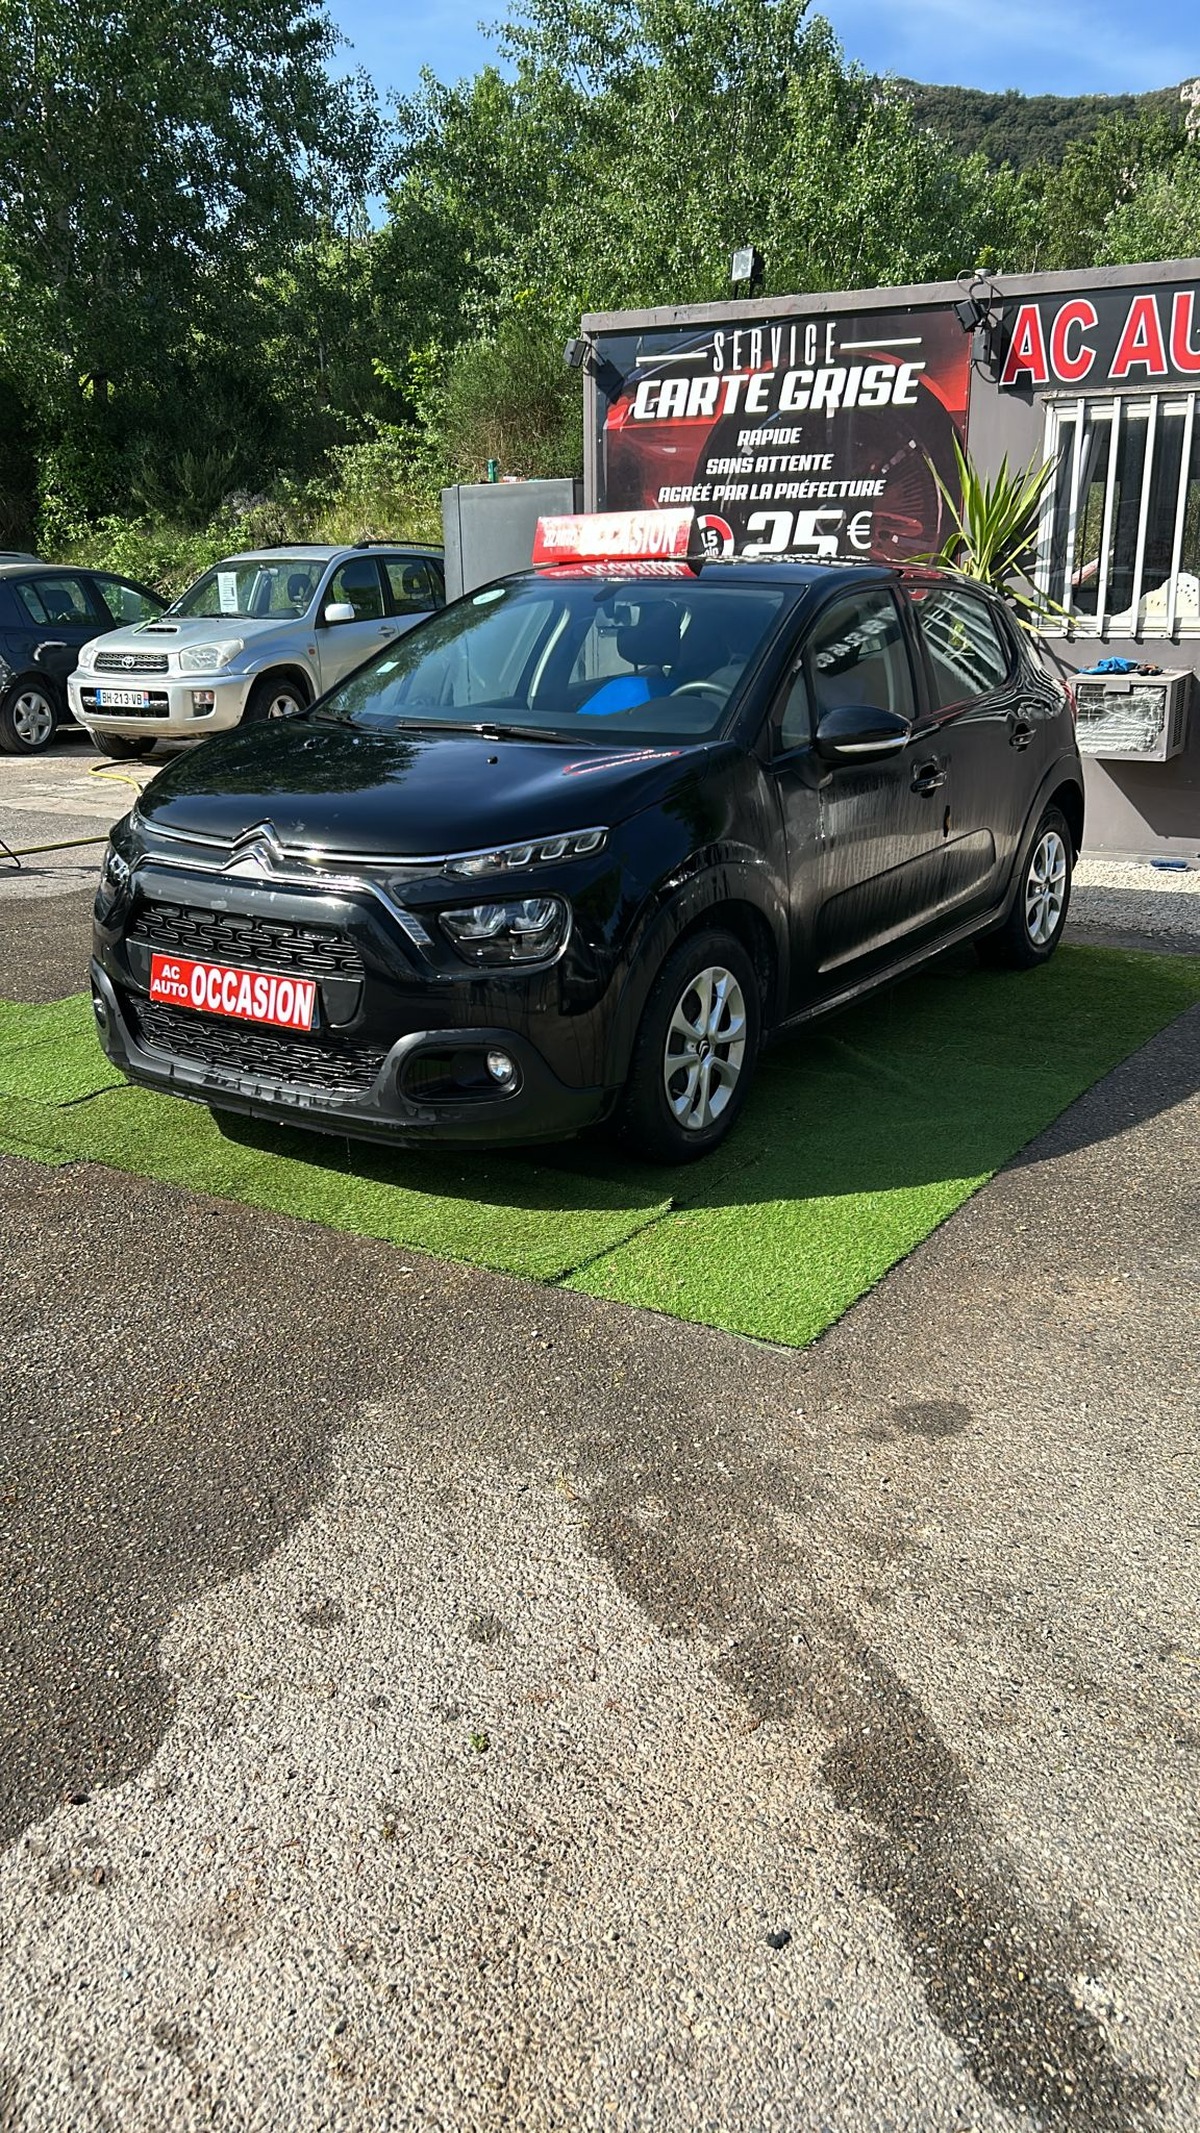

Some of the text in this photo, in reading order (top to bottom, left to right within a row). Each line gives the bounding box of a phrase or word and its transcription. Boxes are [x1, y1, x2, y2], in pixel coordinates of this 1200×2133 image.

[713, 322, 837, 372] SERVICE
[999, 299, 1099, 385] AC
[633, 361, 926, 419] CARTE GRISE
[737, 427, 802, 446] RAPIDE
[706, 453, 834, 474] SANS ATTENTE
[658, 479, 887, 503] AGRÉÉ PAR LA PRÉFECTURE
[101, 692, 143, 705] BH-213-VB
[162, 964, 180, 980] AC
[152, 979, 188, 998] AUTO
[190, 965, 314, 1027] OCCASION
